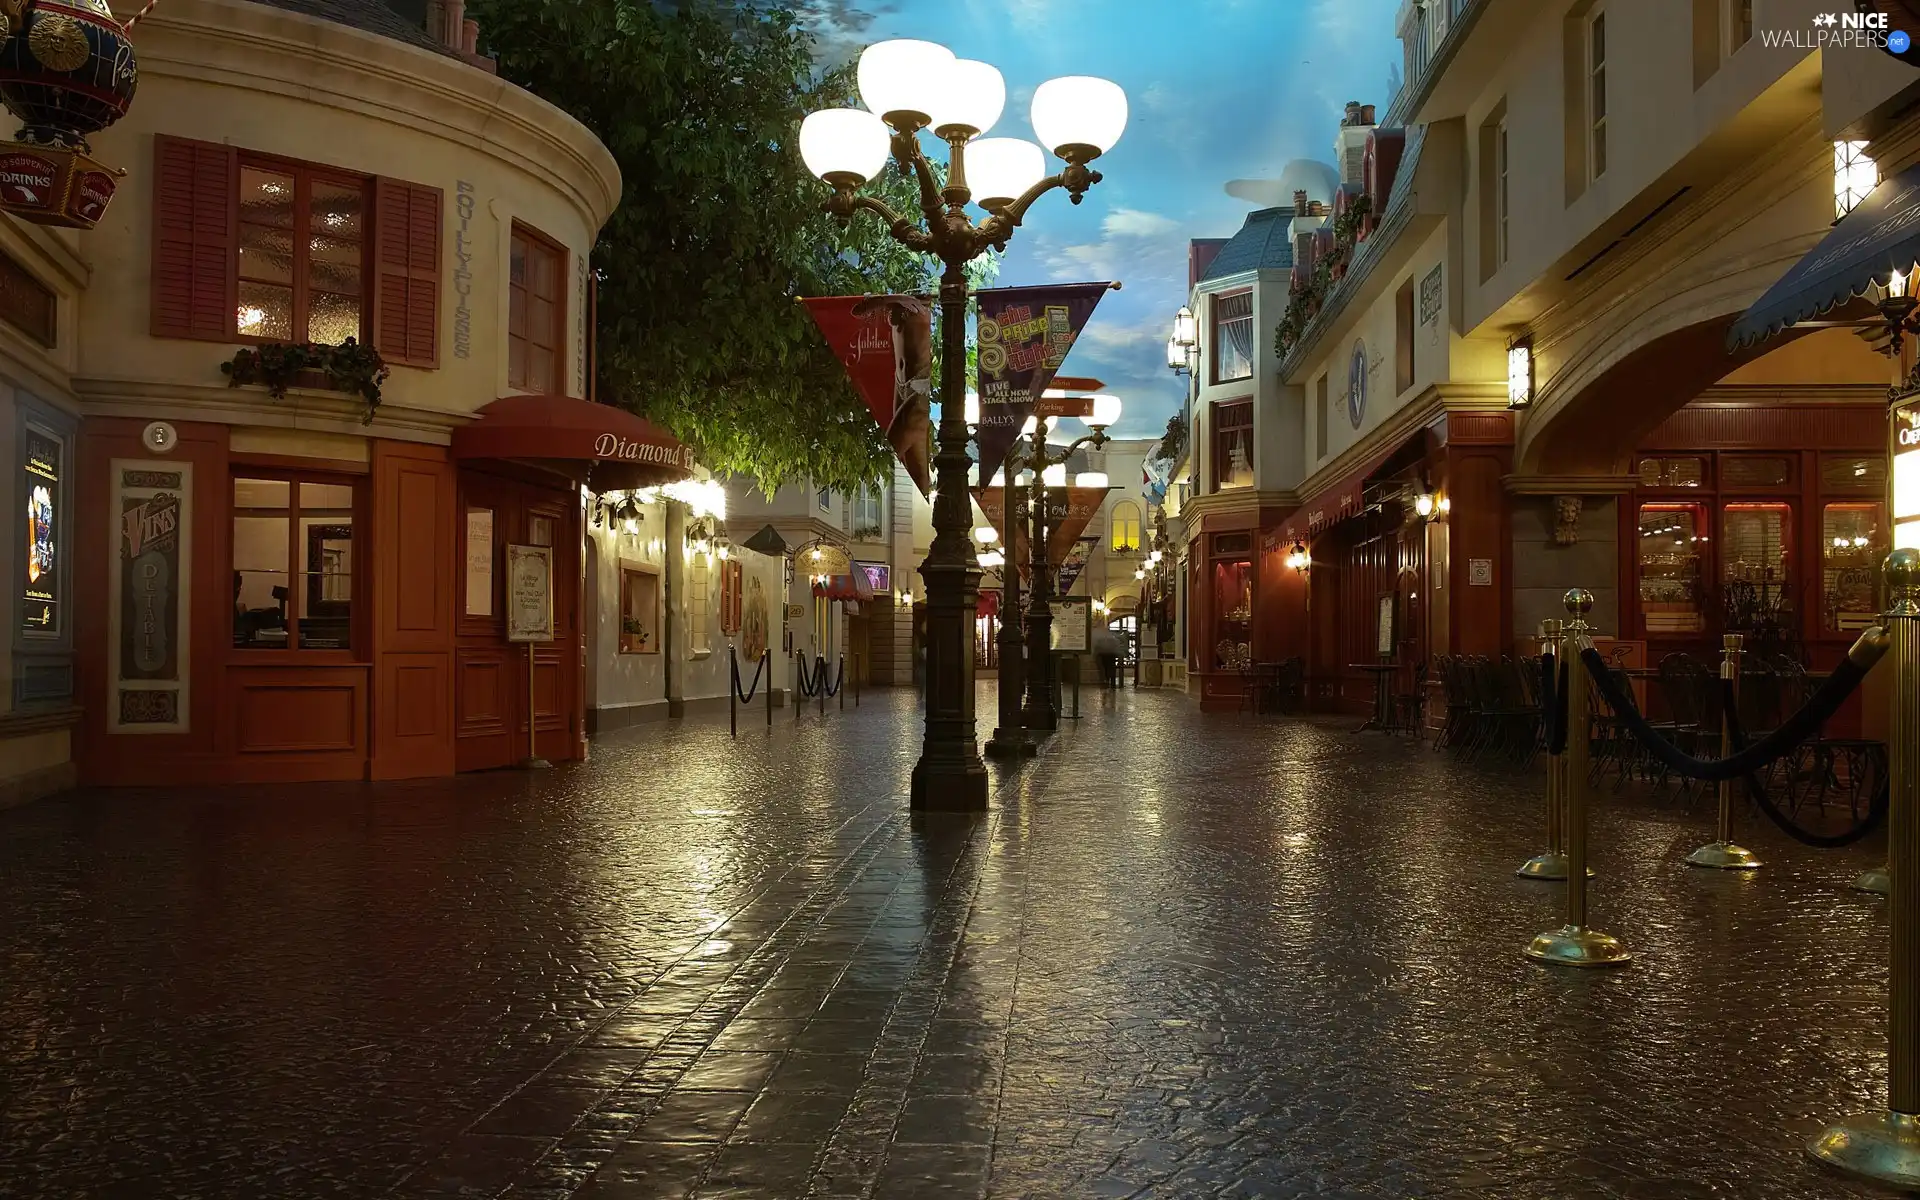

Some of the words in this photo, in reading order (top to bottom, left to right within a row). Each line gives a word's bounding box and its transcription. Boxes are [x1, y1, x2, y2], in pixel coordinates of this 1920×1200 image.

[1, 172, 52, 187] DRINKS
[985, 381, 1010, 397] LIVE
[1011, 388, 1030, 397] NEW
[1009, 396, 1034, 404] SHOW
[1040, 403, 1064, 412] Parking
[982, 415, 1015, 425] BALLY'S
[594, 433, 683, 466] Diamond
[122, 502, 177, 558] VINS
